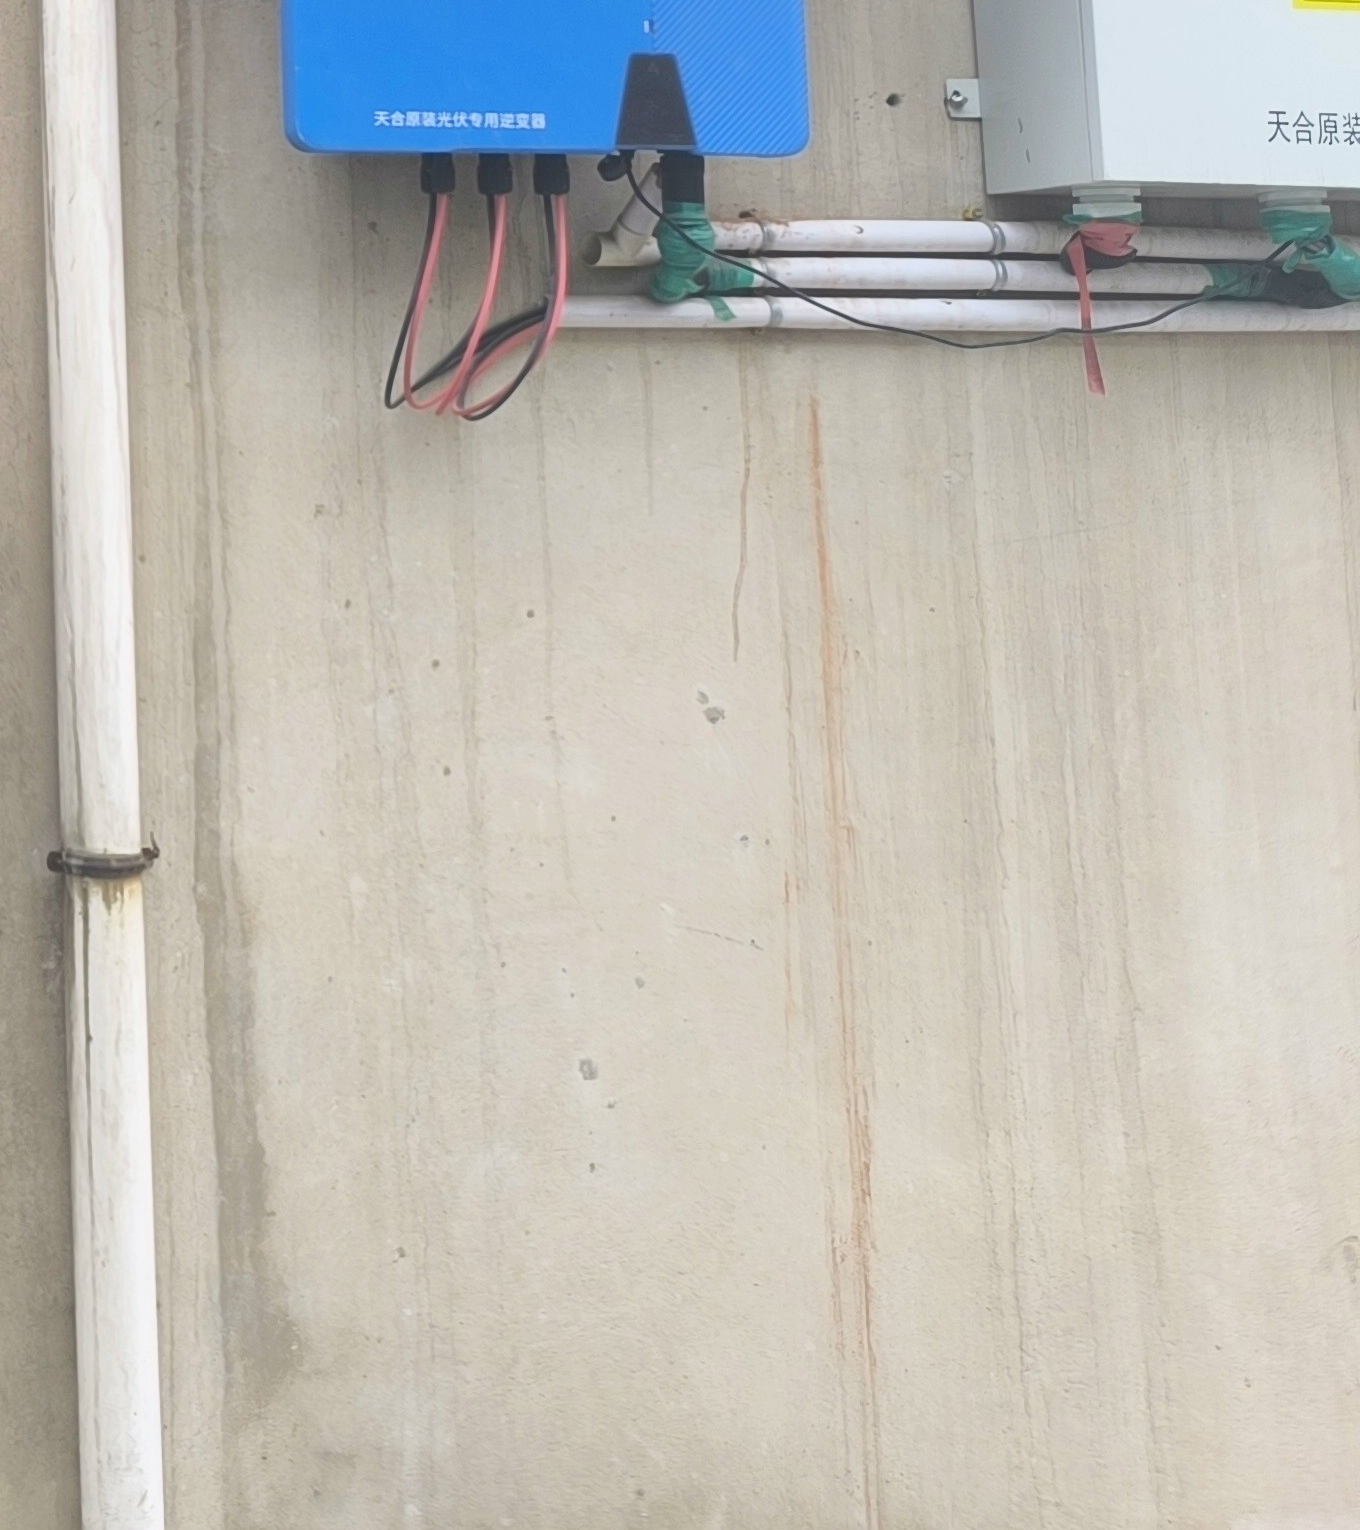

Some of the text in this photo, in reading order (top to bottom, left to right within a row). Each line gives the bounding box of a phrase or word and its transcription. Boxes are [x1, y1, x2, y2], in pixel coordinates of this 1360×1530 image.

[374, 110, 547, 130] 天合原装光伏专用逆变器
[1267, 110, 1360, 145] 天合原装
